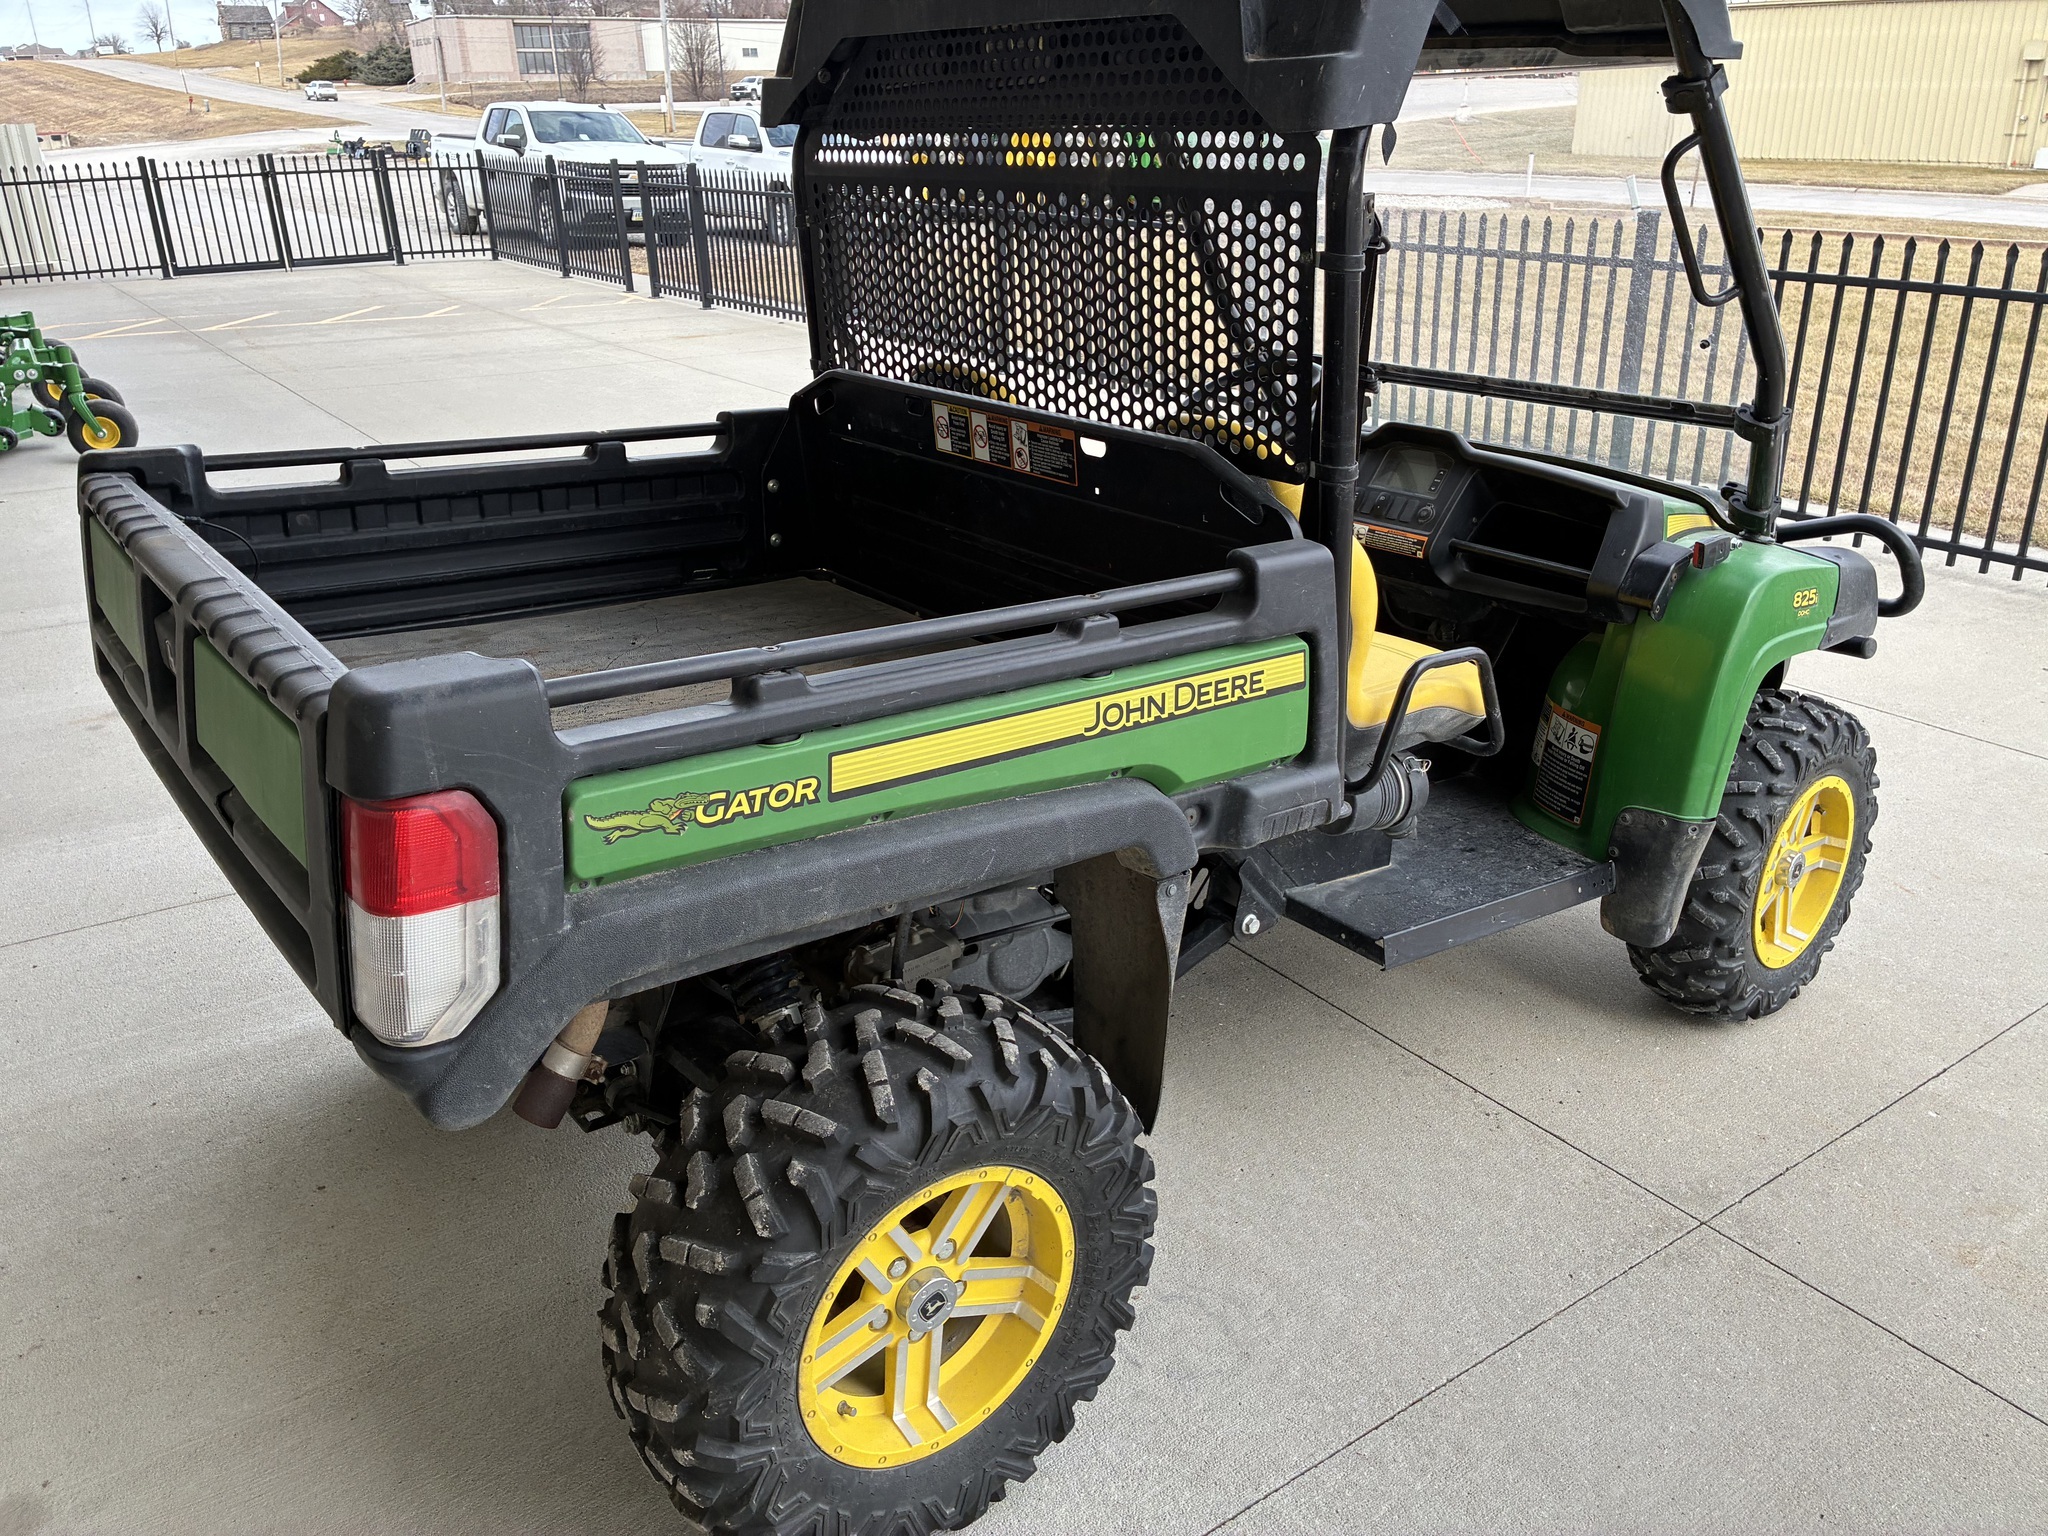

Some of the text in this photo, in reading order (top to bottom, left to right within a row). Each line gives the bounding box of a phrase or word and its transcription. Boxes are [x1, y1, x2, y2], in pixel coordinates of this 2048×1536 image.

[1793, 588, 1819, 608] 825i
[1084, 670, 1265, 733] JOHN DEERE
[694, 776, 820, 827] GATOR
